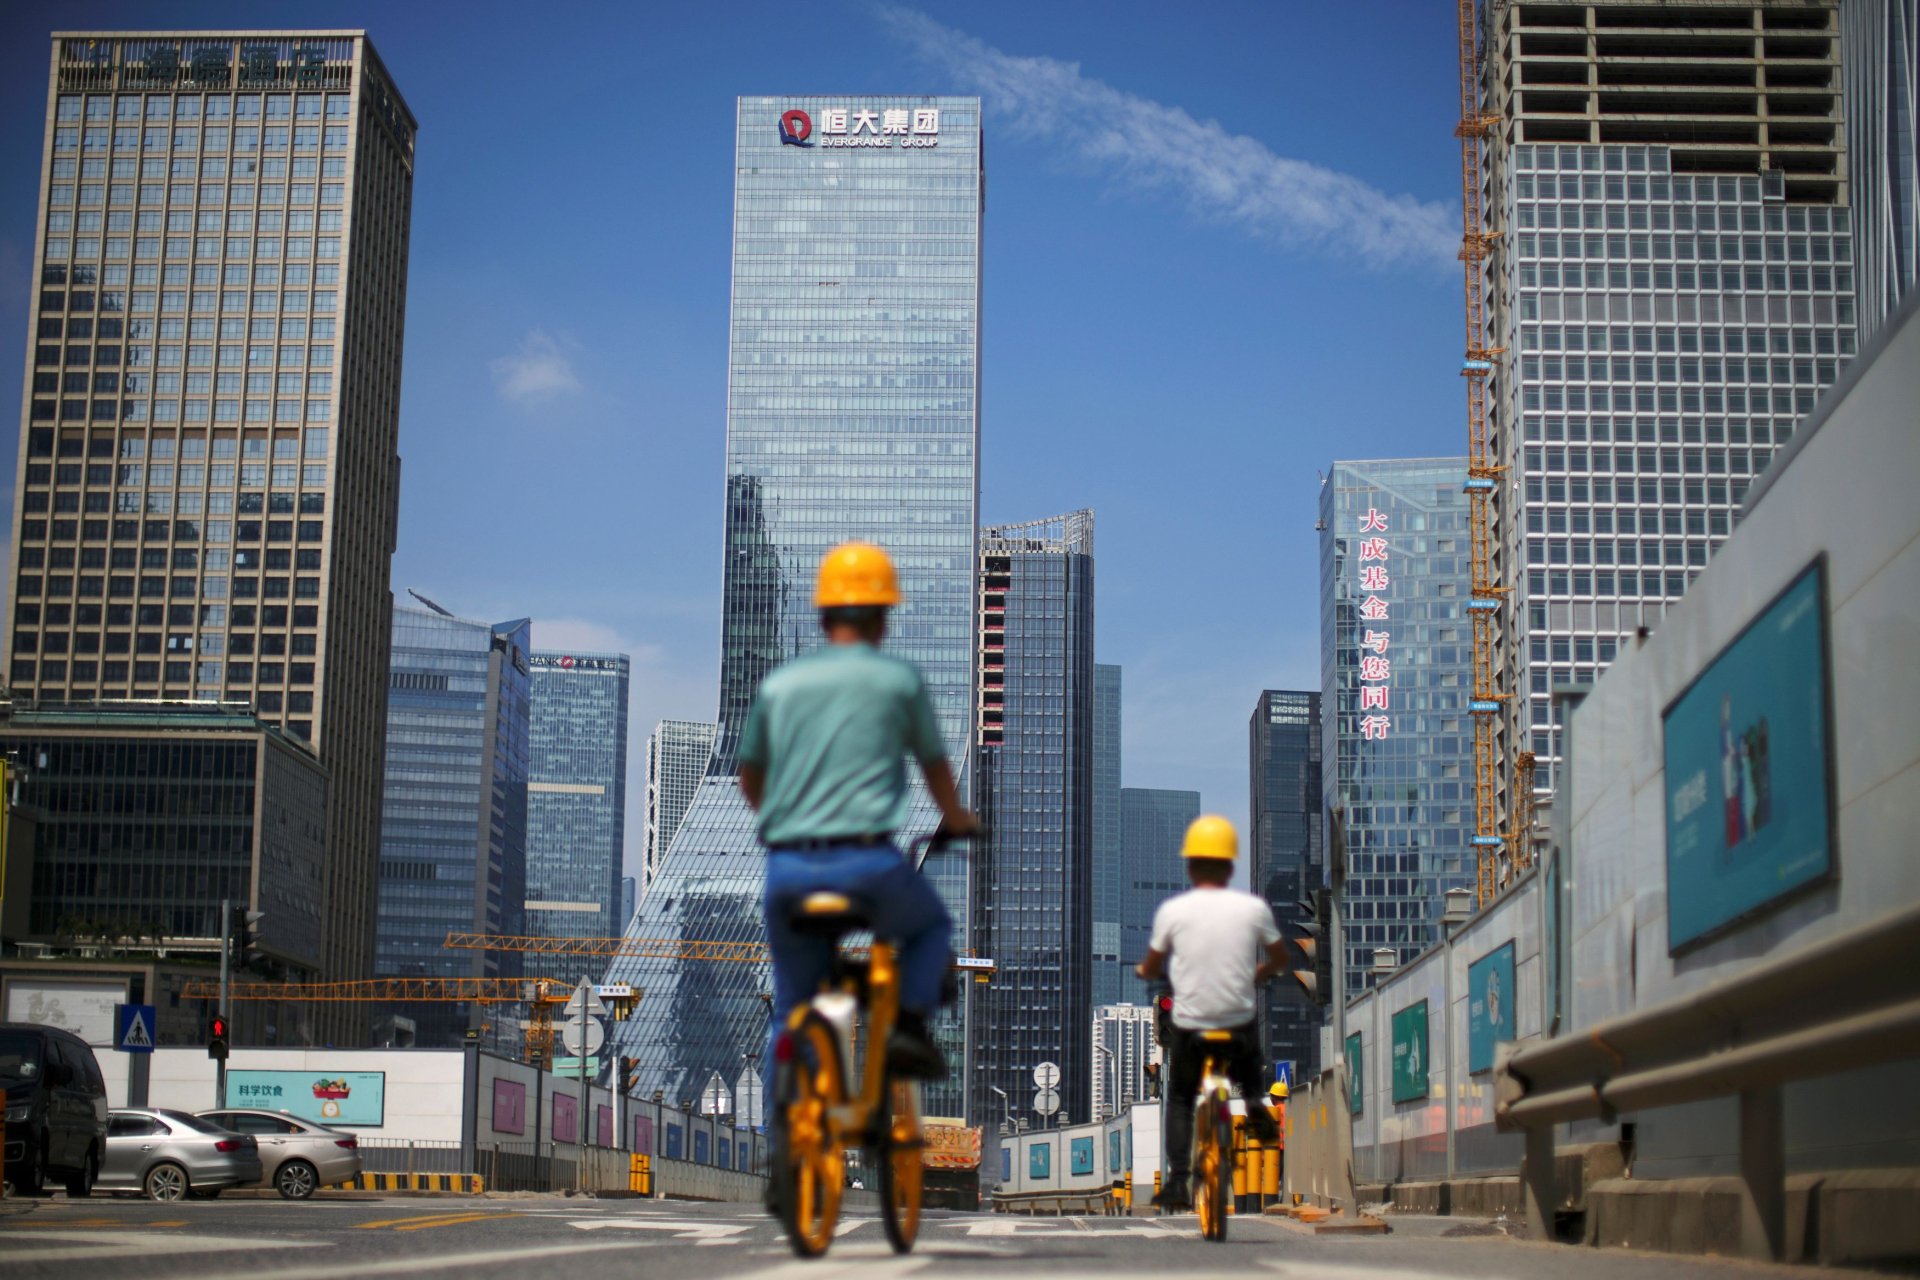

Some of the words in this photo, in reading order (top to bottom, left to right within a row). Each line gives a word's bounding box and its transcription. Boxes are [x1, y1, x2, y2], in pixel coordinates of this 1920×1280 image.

[142, 45, 326, 83] 海德酒店
[821, 109, 939, 135] 恒大集团
[821, 137, 893, 148] EVERGRANDE
[901, 137, 938, 148] GROUP
[1358, 508, 1391, 740] 大成基金与您同行
[529, 656, 559, 666] BANK
[238, 1084, 284, 1097] 科学饮食
